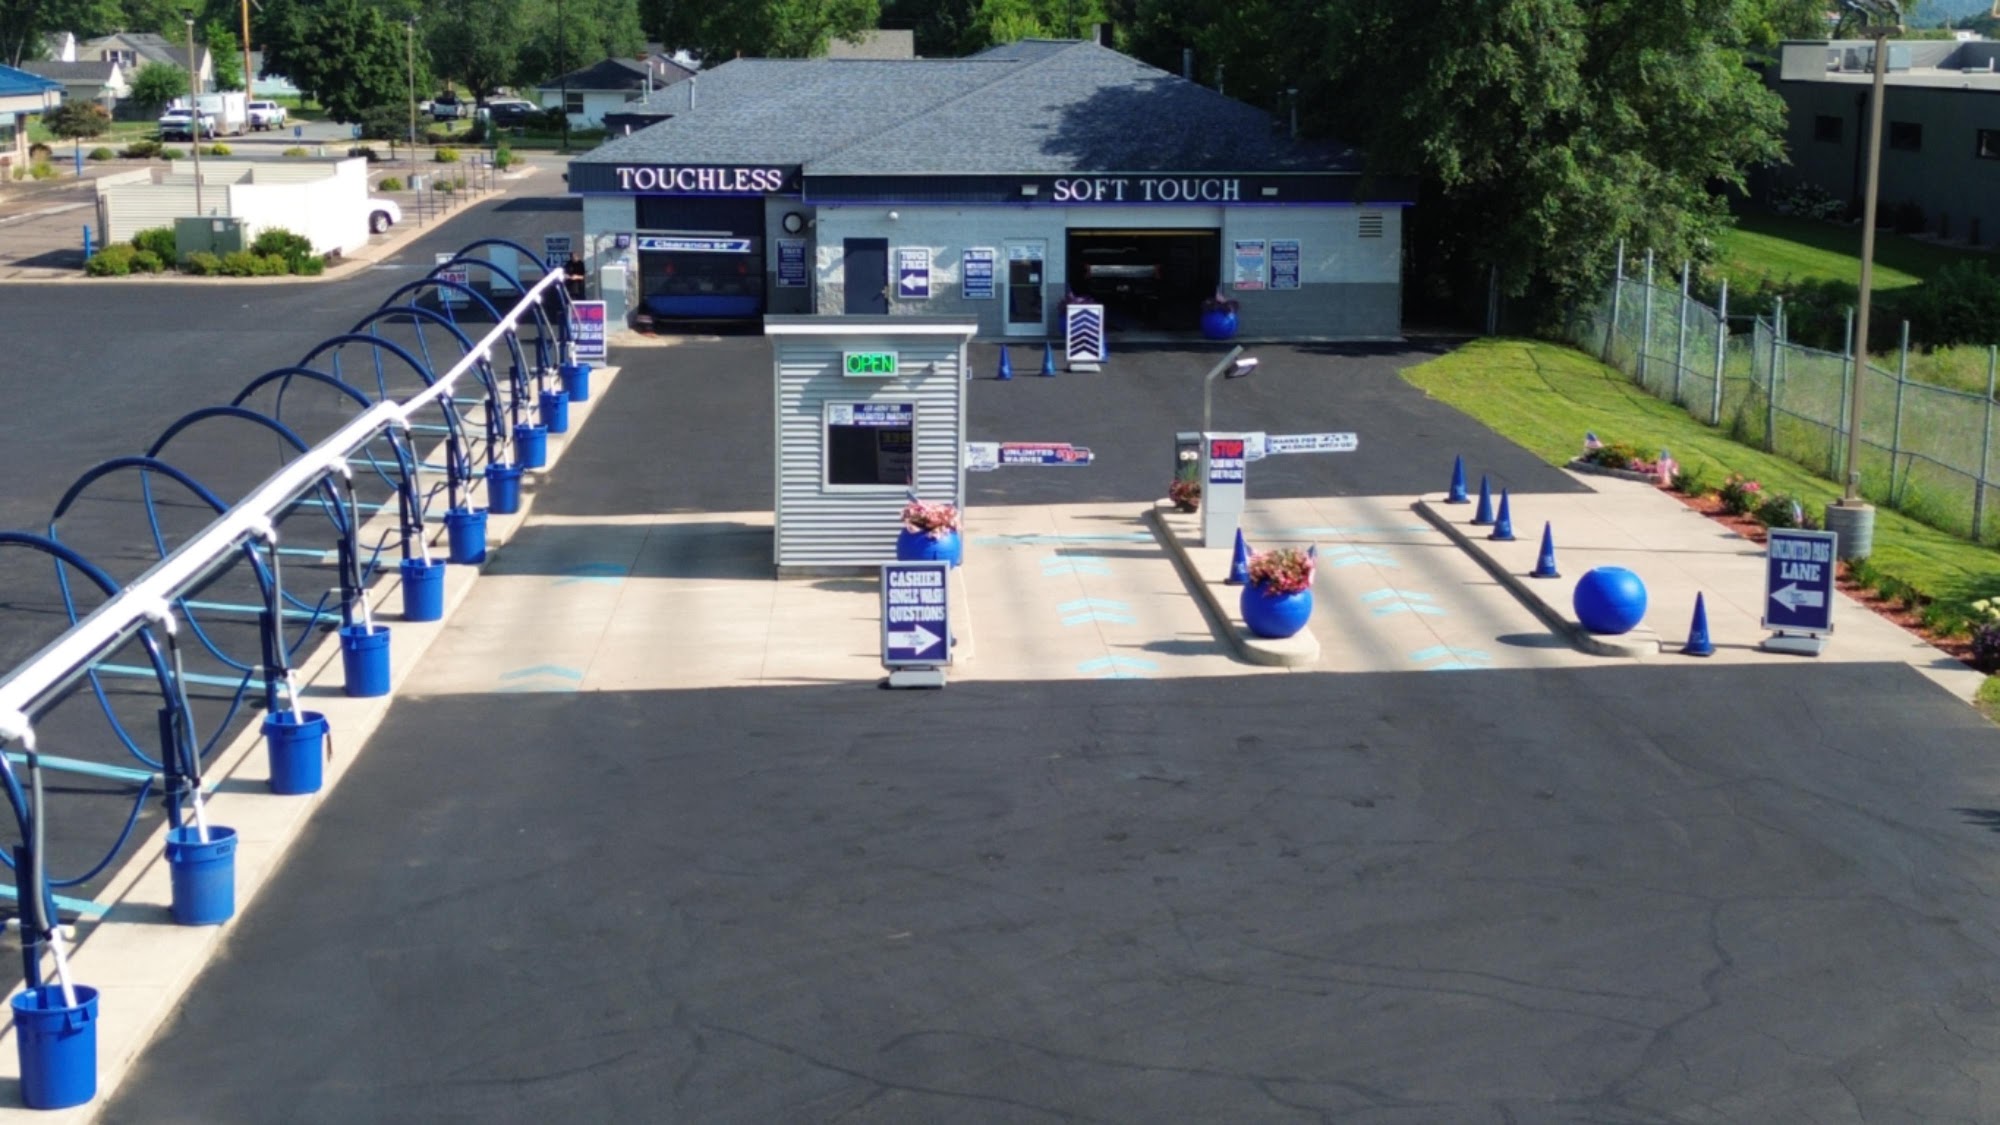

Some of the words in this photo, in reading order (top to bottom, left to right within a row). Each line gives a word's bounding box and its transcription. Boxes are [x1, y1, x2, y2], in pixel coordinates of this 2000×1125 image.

[616, 167, 782, 191] TOUCHLESS
[1053, 178, 1129, 201] SOFT
[1139, 178, 1240, 201] TOUCH
[847, 354, 895, 374] OPEN
[1212, 440, 1243, 457] STOP
[1771, 539, 1811, 560] UNLIMITED
[889, 570, 942, 587] CASHIER
[1780, 561, 1821, 582] LANE
[888, 588, 919, 604] SINGLE
[889, 604, 945, 623] QUESTIONS
